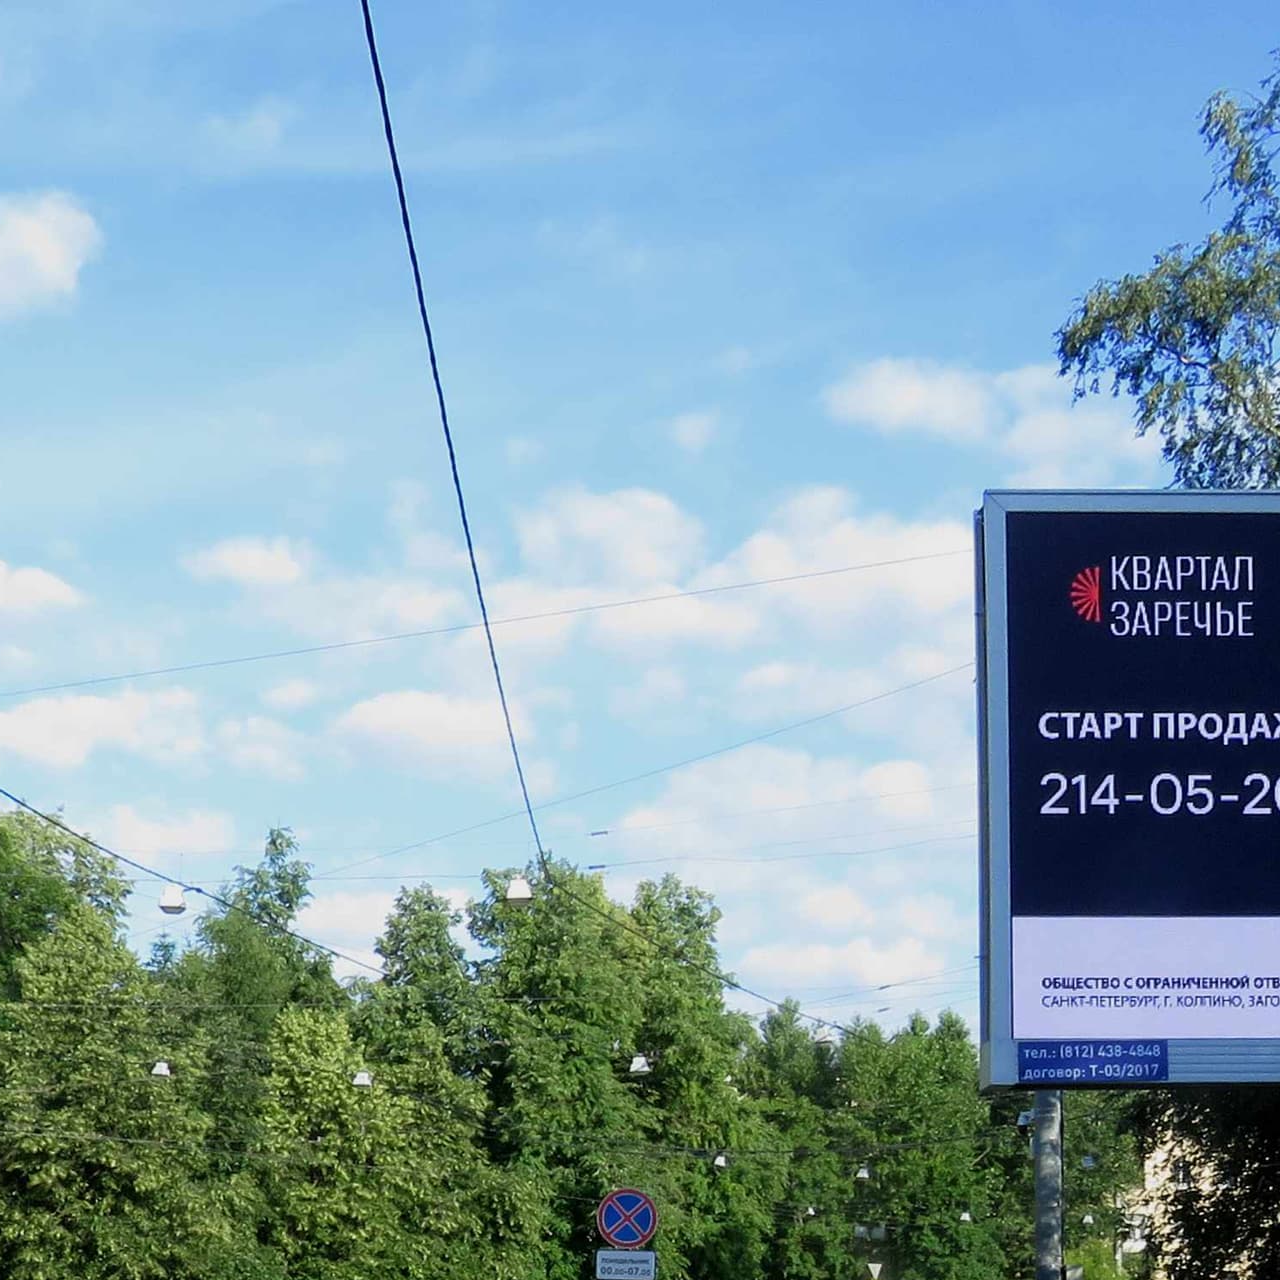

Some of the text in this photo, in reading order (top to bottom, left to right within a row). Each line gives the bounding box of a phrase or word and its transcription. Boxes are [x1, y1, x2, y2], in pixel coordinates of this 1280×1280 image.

[1110, 555, 1255, 592] КВАРТАЛ
[1110, 600, 1255, 637] ЗАРЕЧЬЕ
[1037, 712, 1143, 740] СТАРТ
[1041, 976, 1120, 991] ОБЩЕСТВО
[1123, 977, 1133, 989] С
[1136, 975, 1250, 990] ОГРАНИЧЕННОЙ
[1041, 995, 1161, 1008] САНКТ-ПЕТЕРБУРГ,
[1177, 995, 1246, 1009] КОЛПИНО,
[1025, 1044, 1161, 1059] тел.: (812) 438-4848
[1023, 1064, 1159, 1080] договор: Т-03/2017
